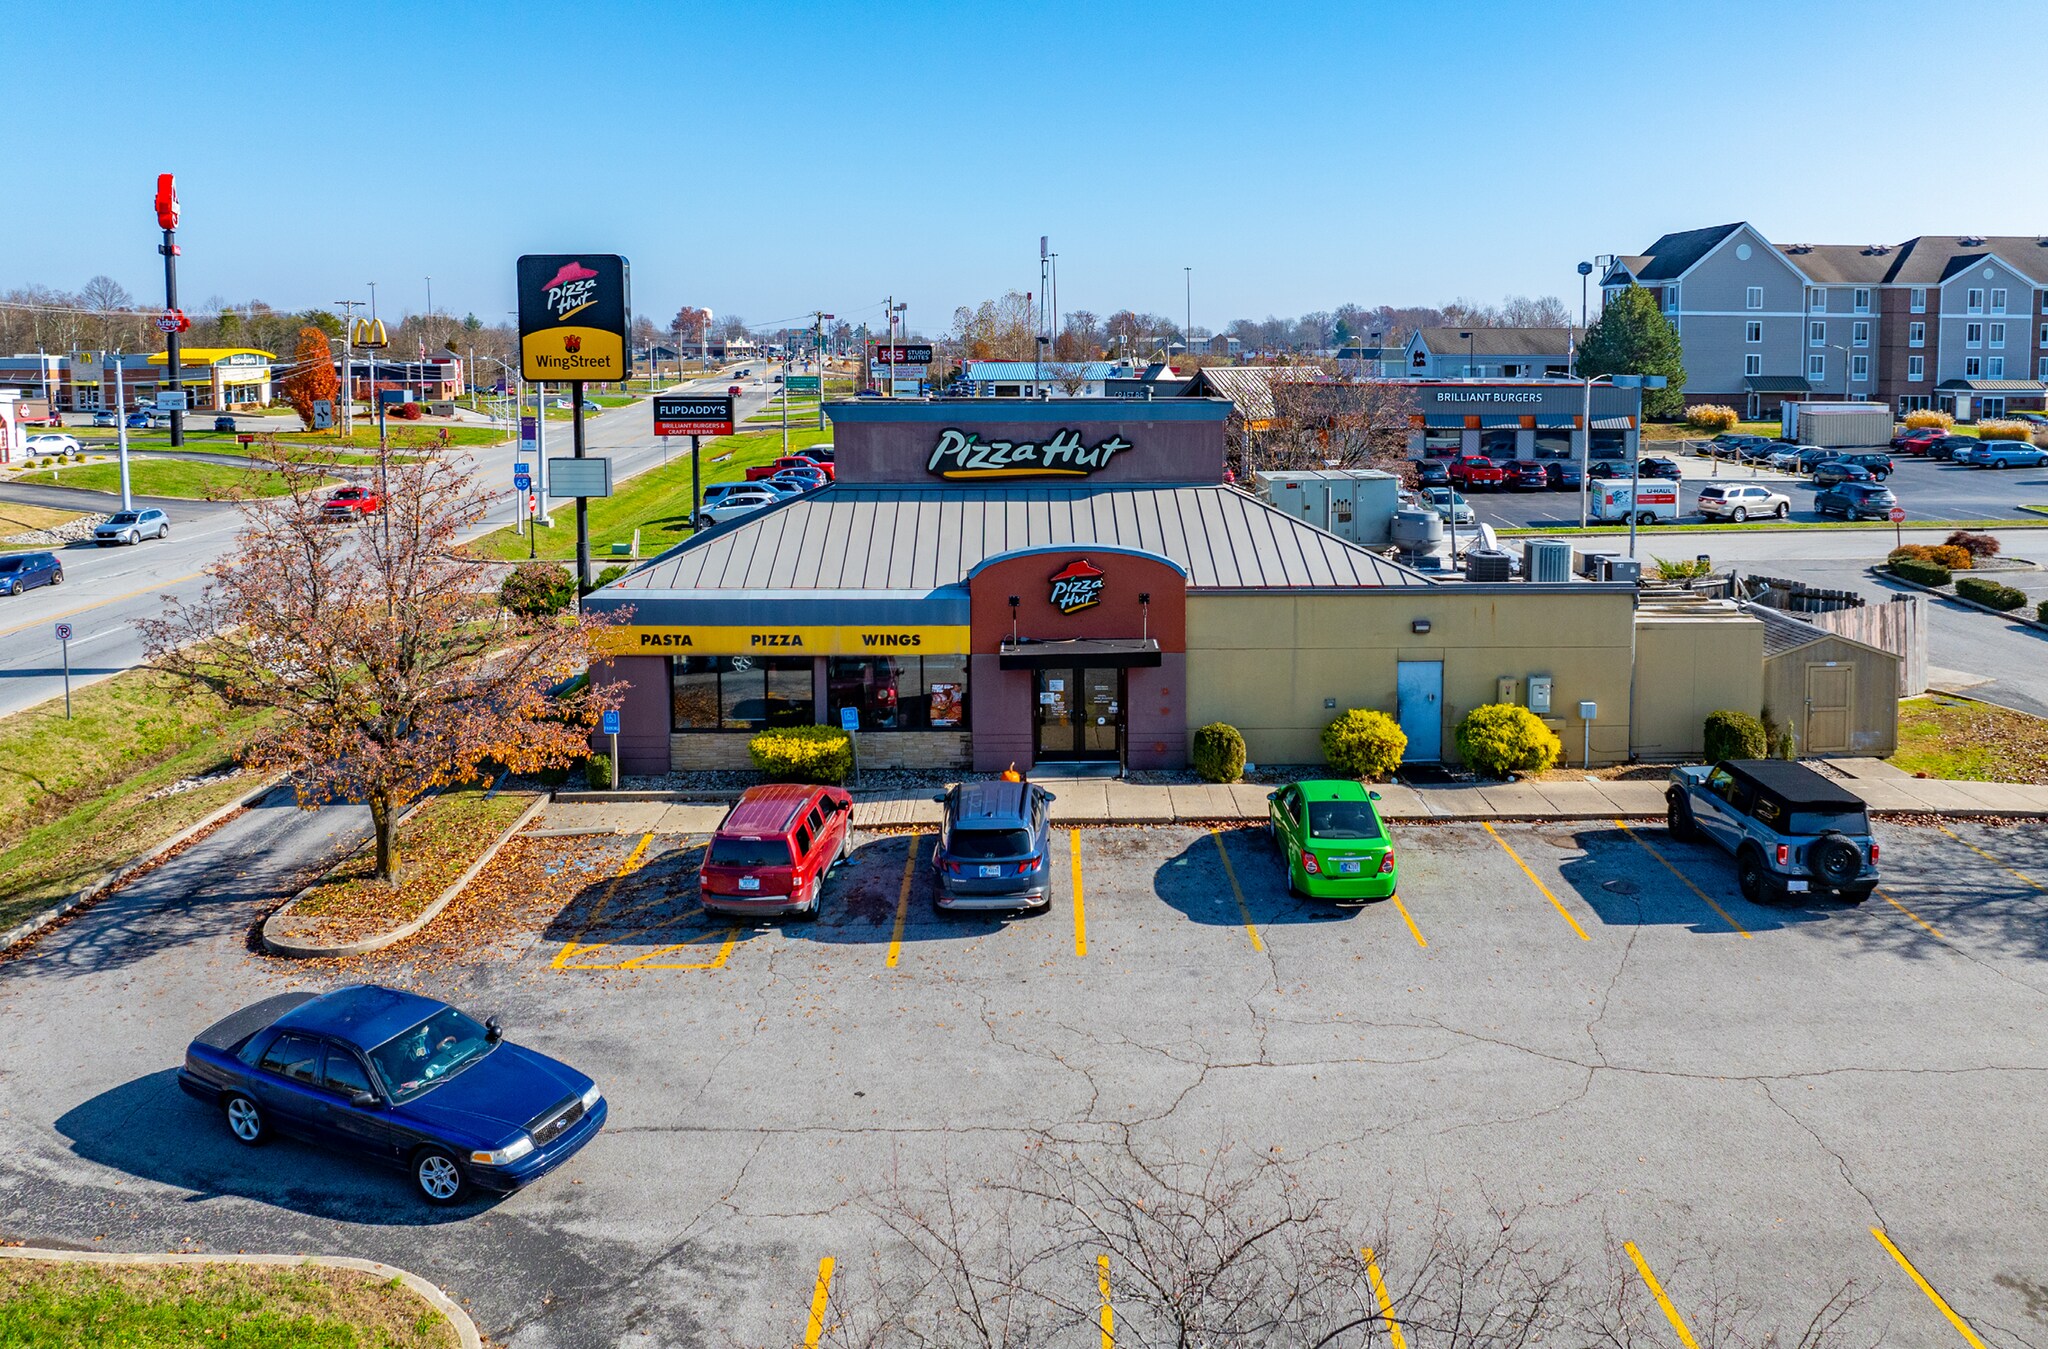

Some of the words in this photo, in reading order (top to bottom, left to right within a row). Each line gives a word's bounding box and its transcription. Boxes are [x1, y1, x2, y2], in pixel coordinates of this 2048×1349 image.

[547, 279, 598, 310] Pizza
[556, 291, 593, 315] Hut
[156, 318, 181, 329] Arby's
[535, 355, 611, 370] WingStreet
[1437, 392, 1491, 402] BRILLIANT
[1493, 393, 1542, 403] BURGERS
[659, 405, 726, 415] FLIPDADDY'S
[928, 430, 1037, 471] Pizza
[1041, 430, 1131, 467] Hut
[514, 464, 529, 473] JCT
[516, 478, 528, 488] 65
[1050, 576, 1103, 603] Pizza
[1059, 590, 1097, 609] Hut
[640, 634, 693, 646] PASTA
[751, 634, 803, 647] PIZZA
[861, 634, 921, 646] WINGS
